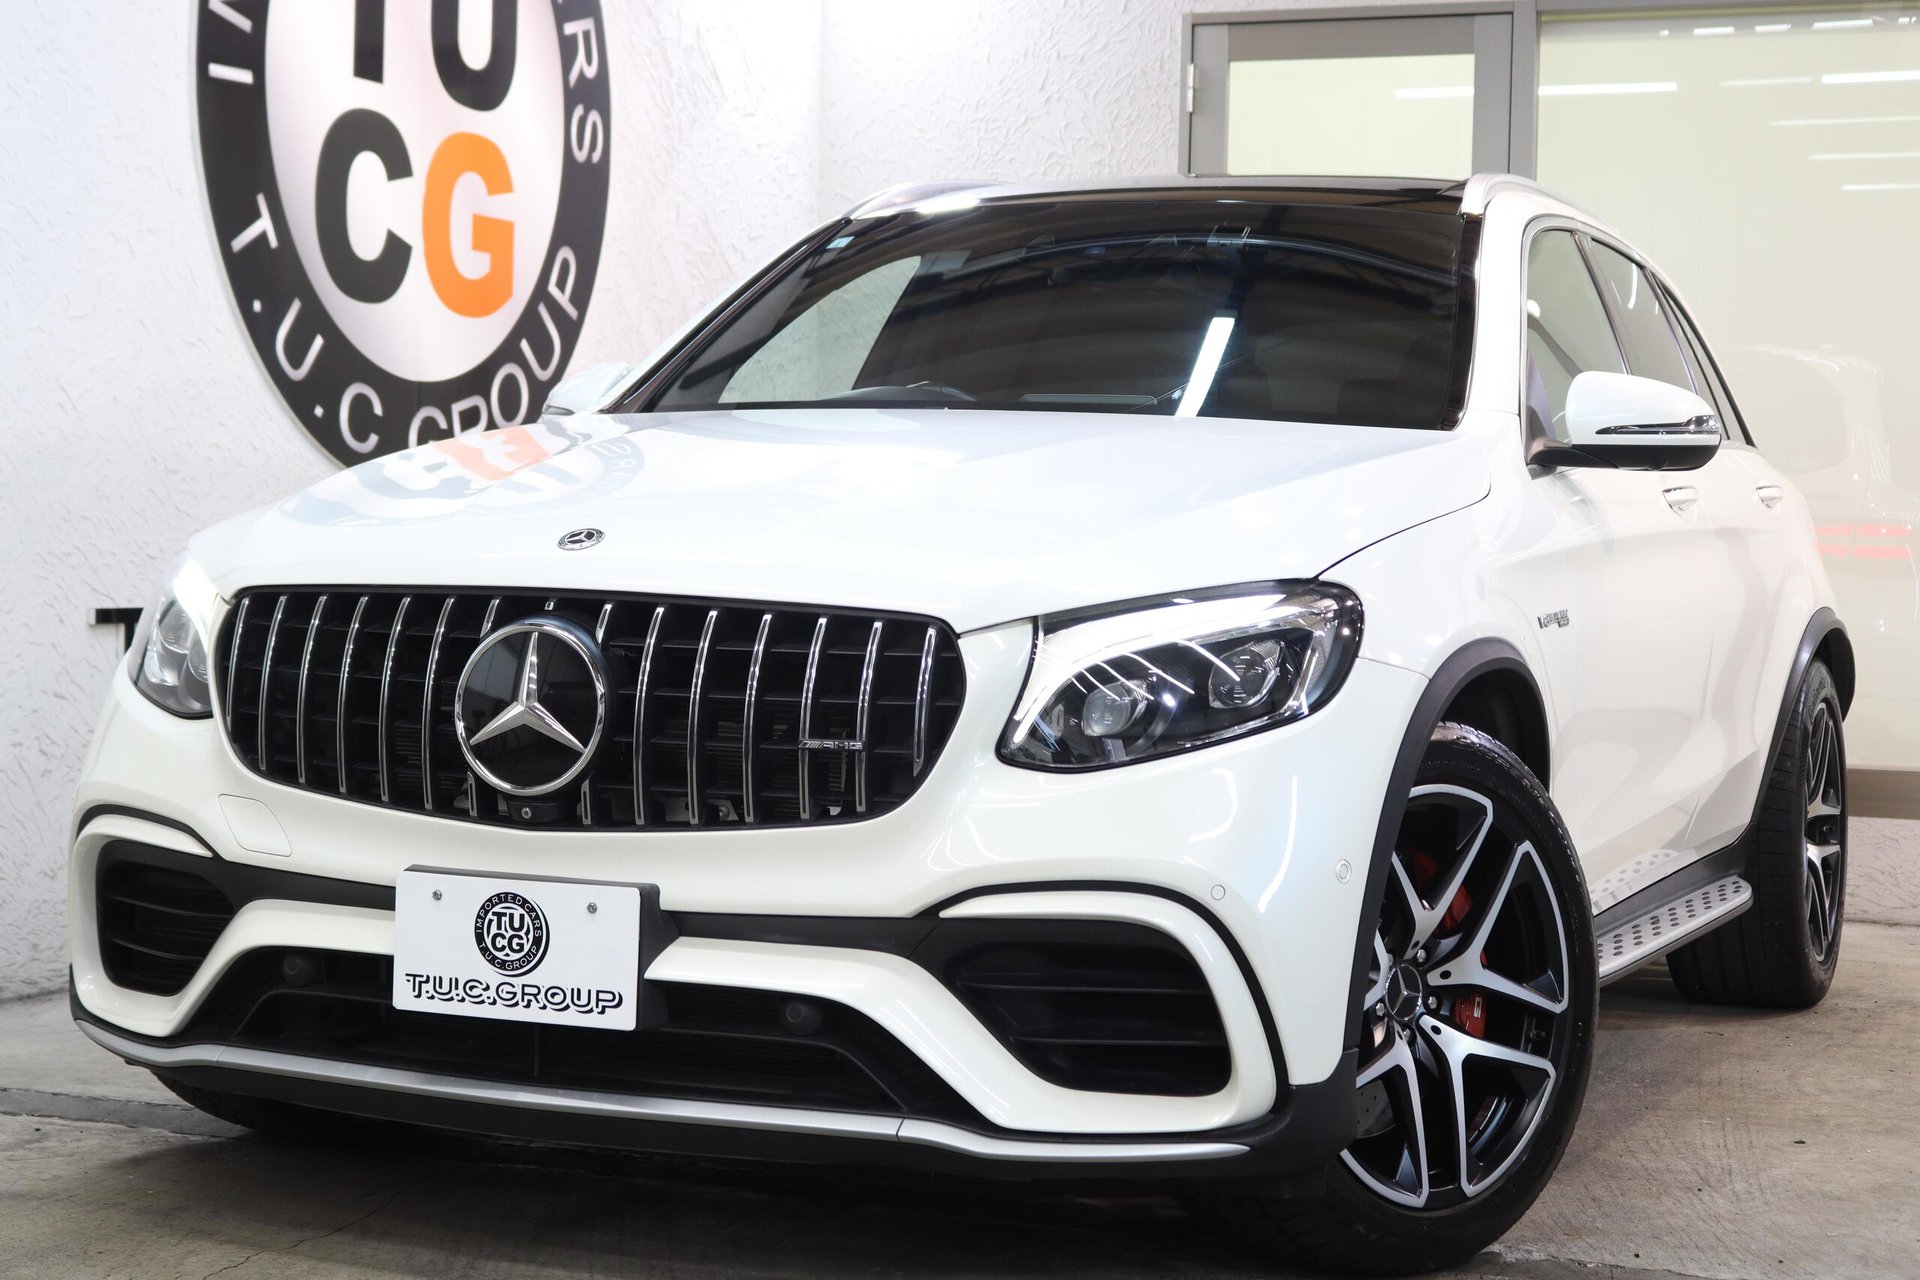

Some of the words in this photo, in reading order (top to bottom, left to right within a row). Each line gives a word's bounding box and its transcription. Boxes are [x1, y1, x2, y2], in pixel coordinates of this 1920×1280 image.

[315, 108, 515, 318] CG
[820, 740, 863, 750] AMG
[476, 894, 523, 933] IMPORTED
[524, 903, 542, 937] CARS
[492, 911, 525, 933] TU
[491, 932, 525, 954] CG
